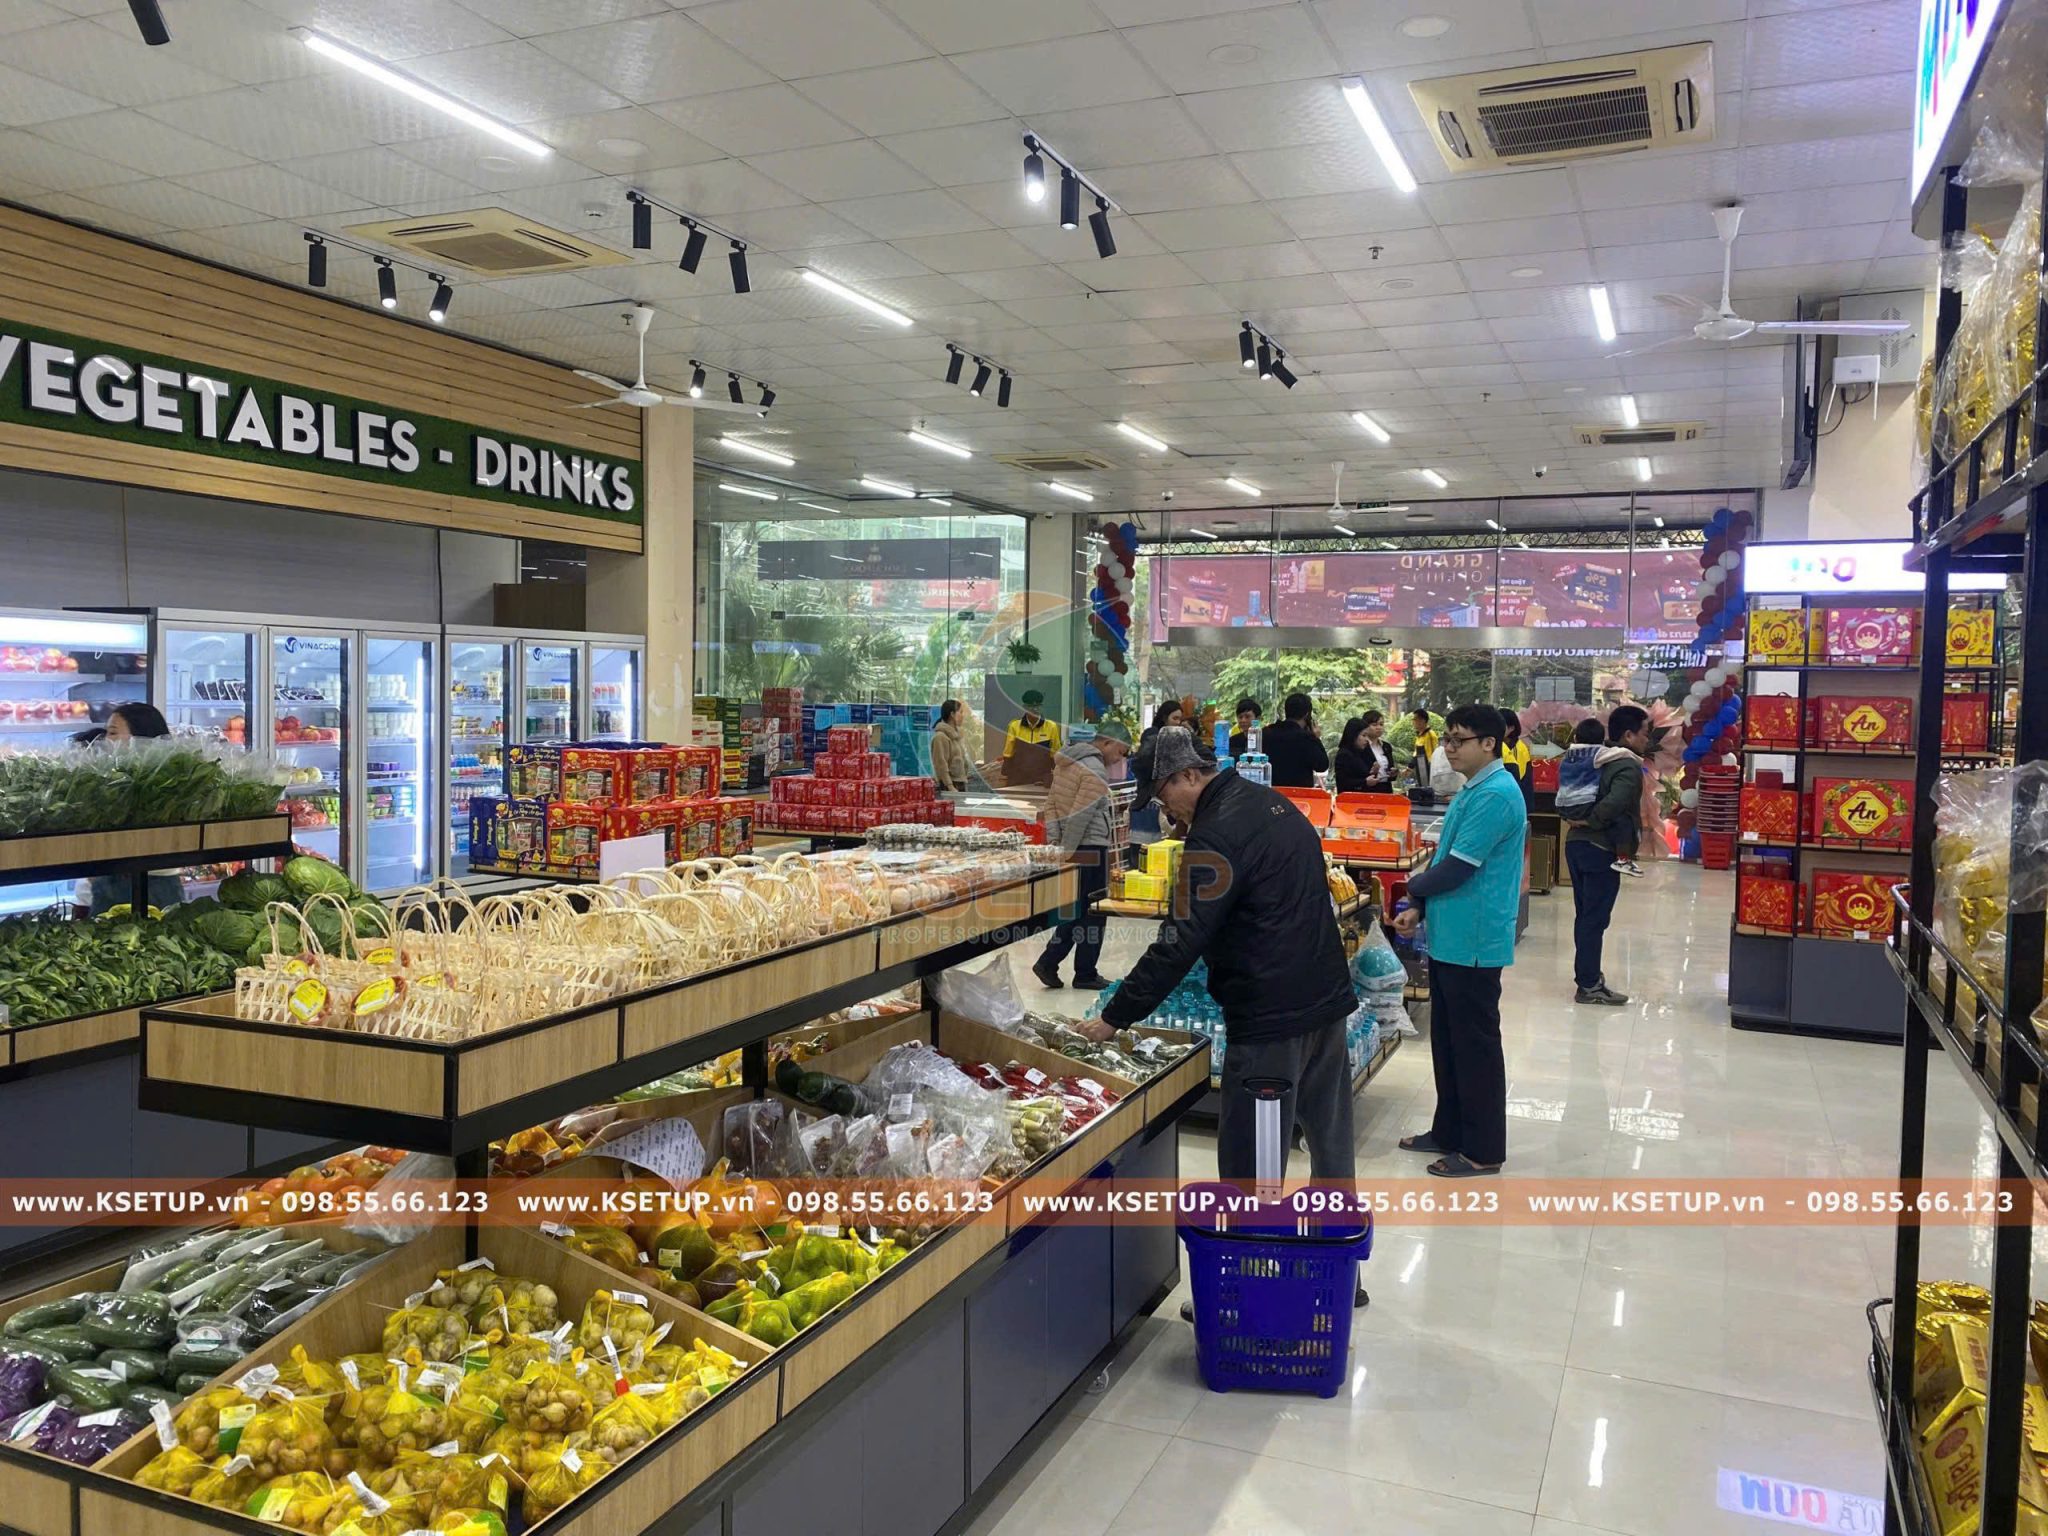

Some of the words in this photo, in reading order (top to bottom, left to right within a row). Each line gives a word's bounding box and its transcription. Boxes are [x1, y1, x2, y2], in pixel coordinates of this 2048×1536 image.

[436, 449, 454, 463] -
[473, 435, 635, 513] DRINKS
[299, 642, 340, 650] VINACOOL
[1850, 714, 1880, 732] An
[1848, 800, 1880, 820] An
